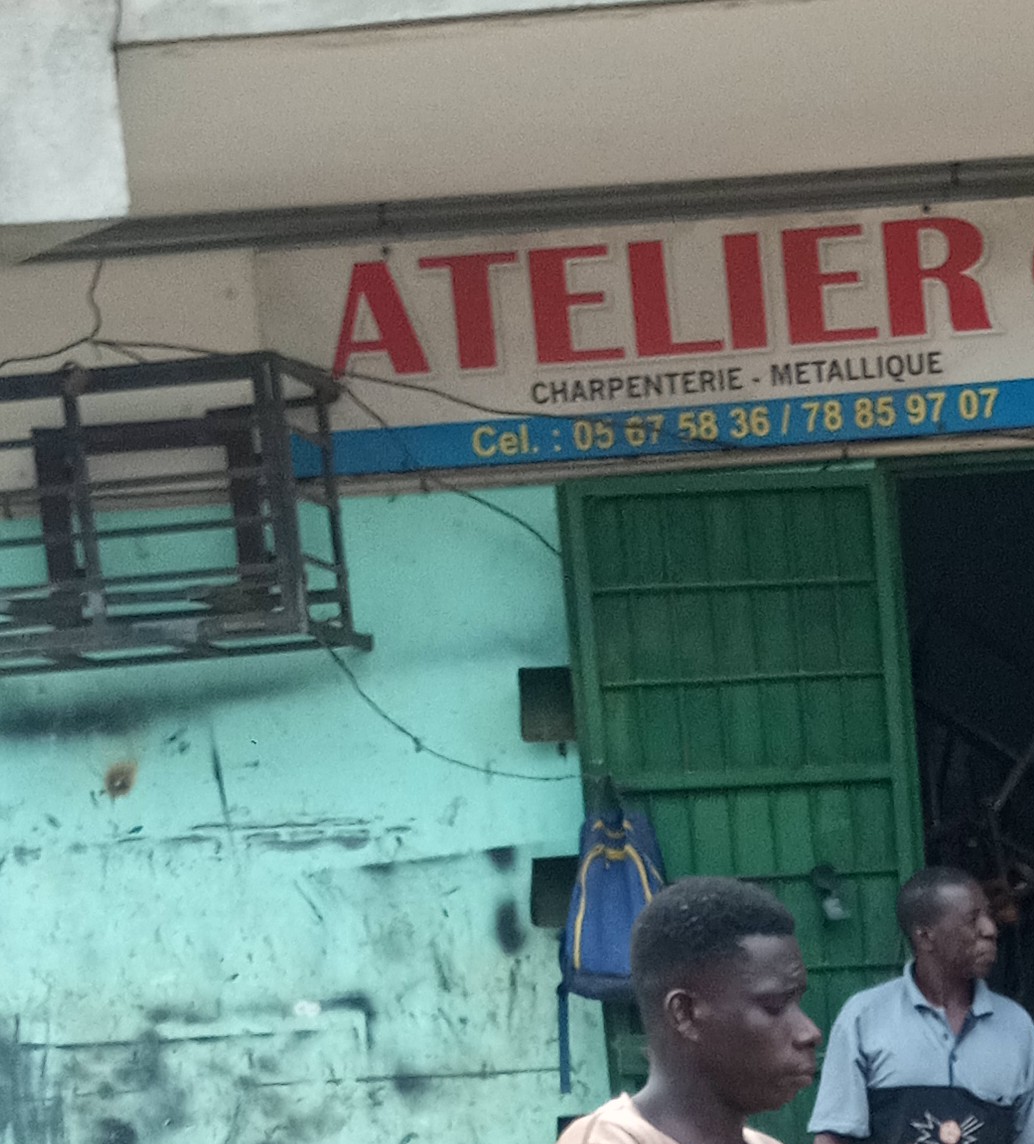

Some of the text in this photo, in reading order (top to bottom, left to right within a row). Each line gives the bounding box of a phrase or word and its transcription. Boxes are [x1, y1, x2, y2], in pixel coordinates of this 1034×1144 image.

[332, 216, 993, 378] ATELIER
[531, 367, 743, 405] CHARPENTERIE
[769, 352, 943, 387] METALLIQUE
[471, 423, 539, 457] Cel.
[573, 418, 615, 450] 05
[624, 414, 665, 447] 67
[678, 410, 719, 442] 58
[729, 406, 770, 439] 36
[780, 403, 791, 436] /
[802, 400, 843, 432] 78
[854, 396, 896, 428] 85
[906, 392, 946, 425] 97
[959, 388, 998, 420] 07
